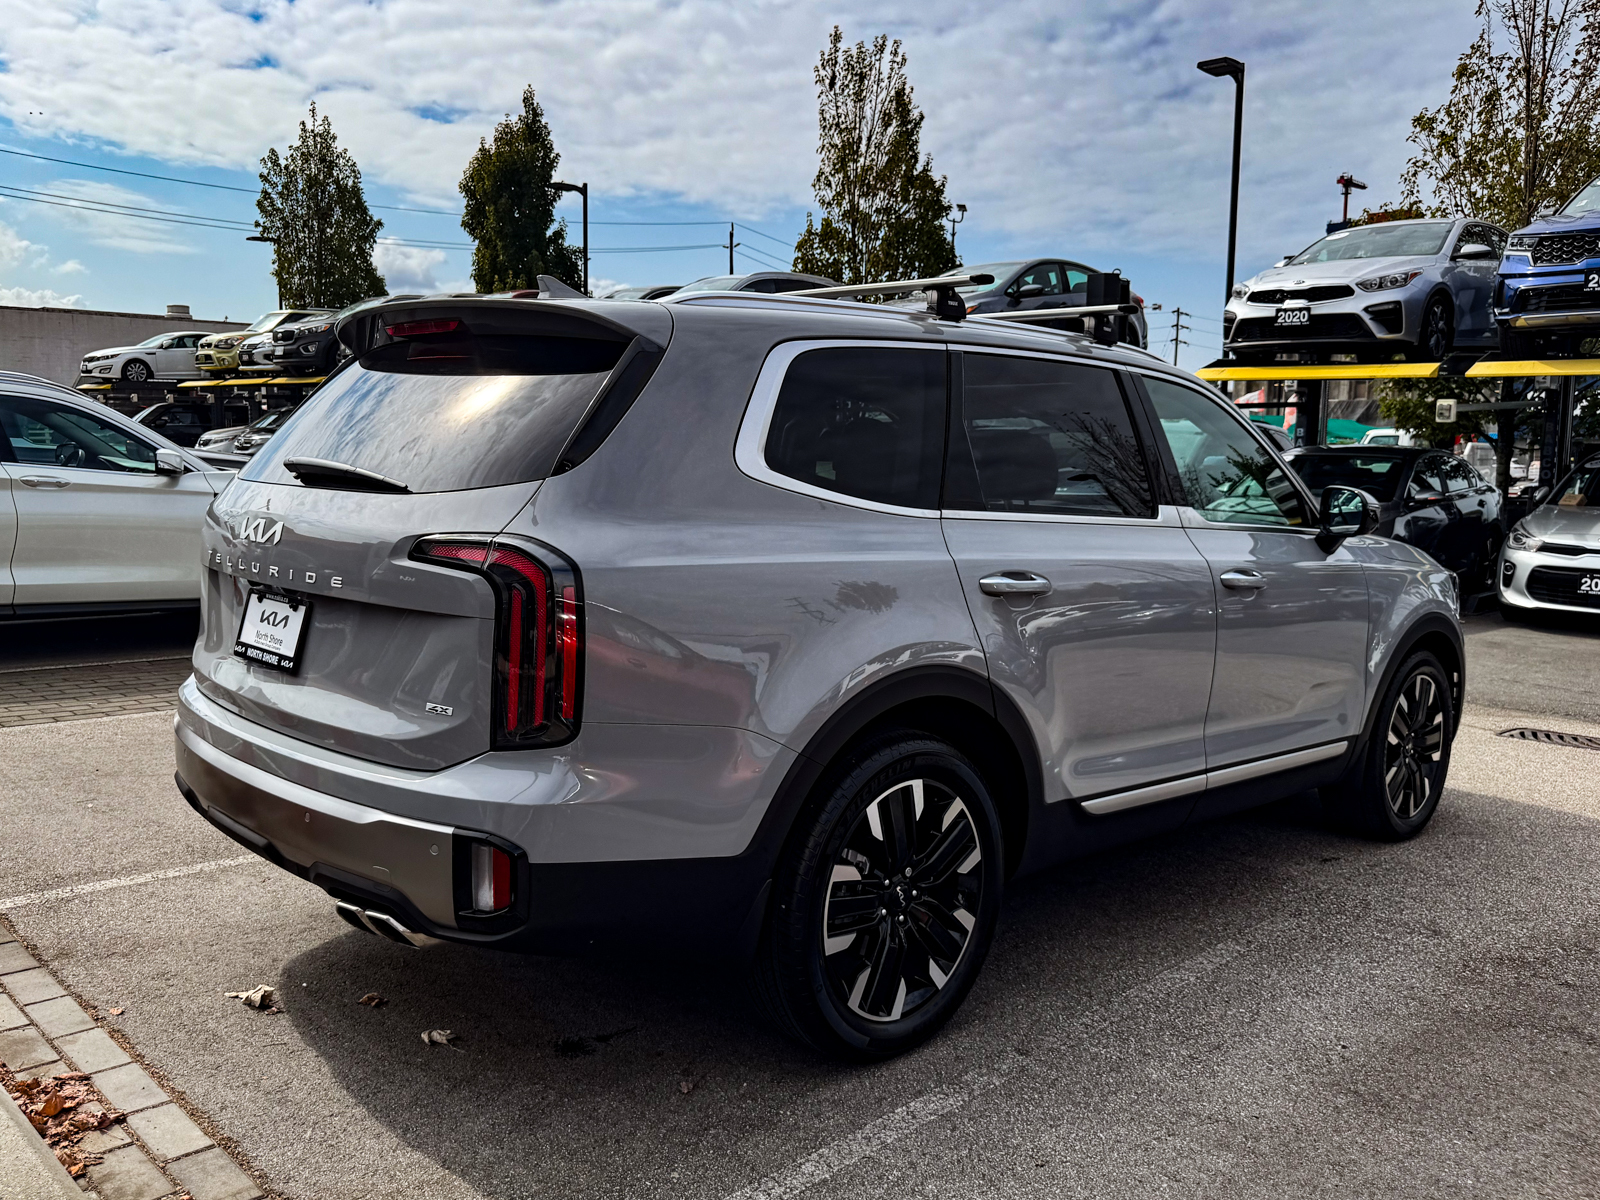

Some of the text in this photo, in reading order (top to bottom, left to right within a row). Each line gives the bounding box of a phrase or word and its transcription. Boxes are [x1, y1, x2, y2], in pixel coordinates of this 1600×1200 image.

[1277, 310, 1309, 323] 2020
[239, 516, 284, 545] KIA
[207, 550, 343, 588] TELLURIDE
[259, 608, 290, 630] KIA
[255, 630, 269, 642] North
[269, 633, 284, 646] Shore
[246, 647, 263, 660] NORTH
[262, 652, 280, 665] SHORE
[846, 758, 914, 821] MICHELIN
